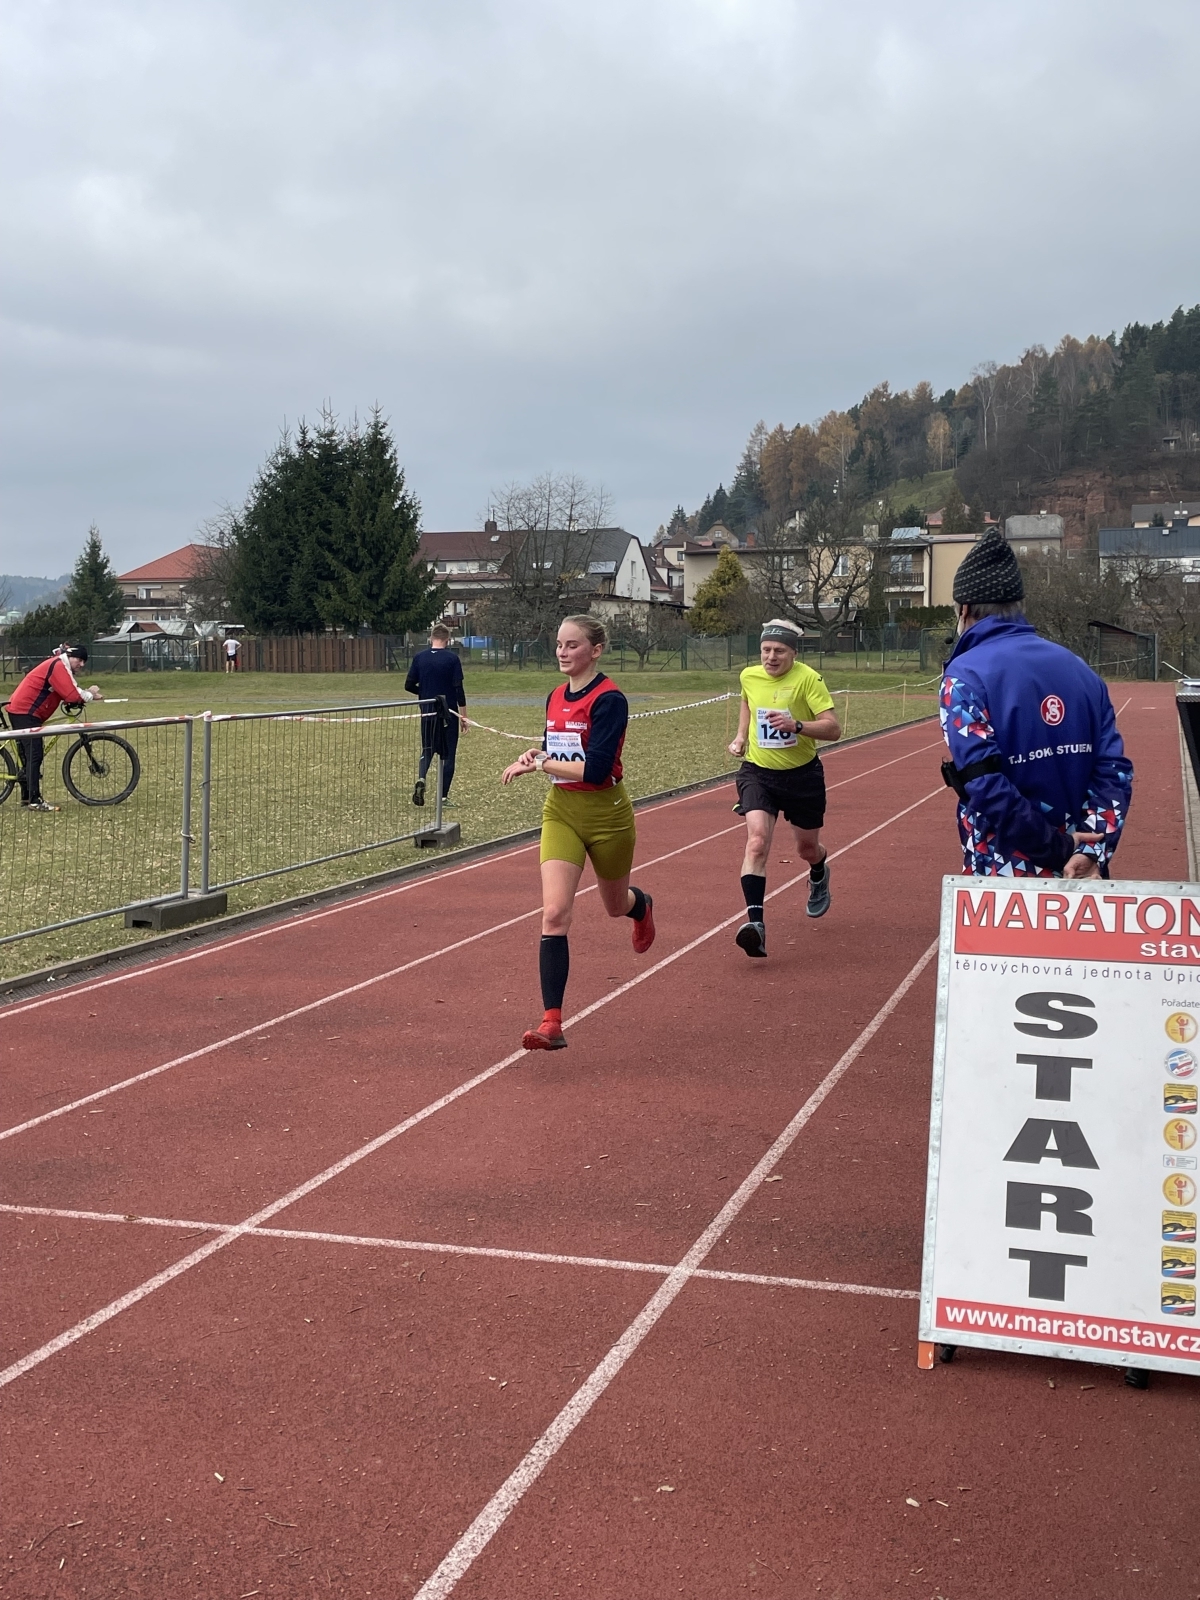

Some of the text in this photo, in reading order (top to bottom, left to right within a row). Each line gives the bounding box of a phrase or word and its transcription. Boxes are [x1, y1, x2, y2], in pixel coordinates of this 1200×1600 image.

[1028, 747, 1054, 761] SOK
[955, 960, 1073, 977] tělovýchovná
[1083, 965, 1152, 981] jednota
[945, 1305, 1200, 1354] www.maratonstav.cz
